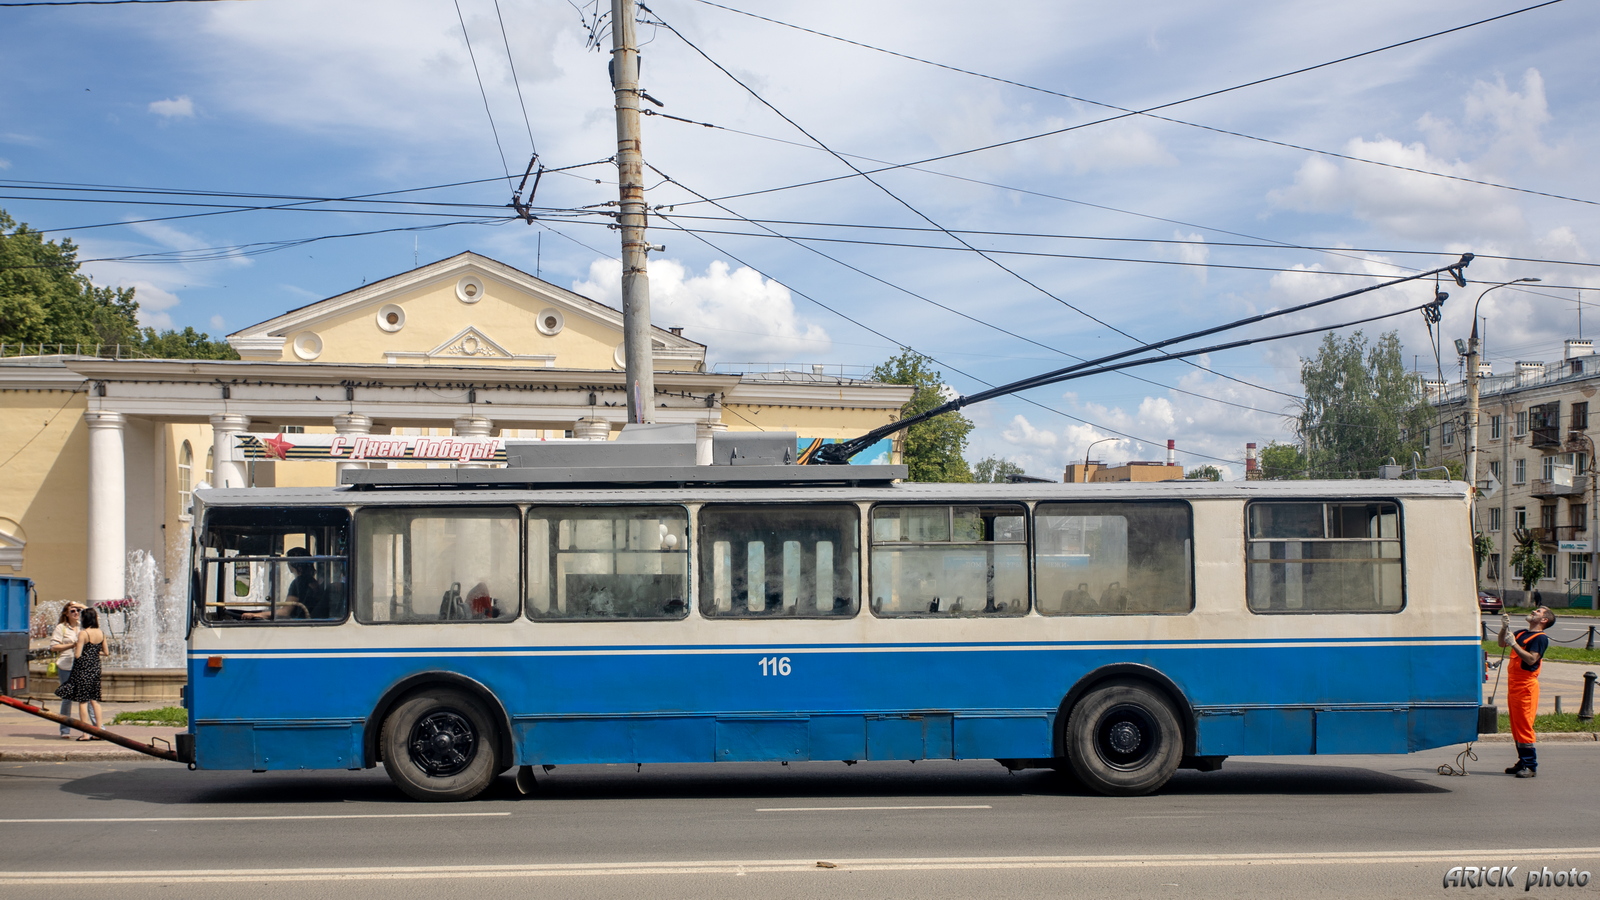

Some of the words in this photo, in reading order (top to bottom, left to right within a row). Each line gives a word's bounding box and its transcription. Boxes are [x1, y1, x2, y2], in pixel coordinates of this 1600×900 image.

[330, 436, 347, 457] С
[348, 437, 408, 459] Днем
[412, 438, 499, 463] Победы!
[758, 656, 792, 676] 116
